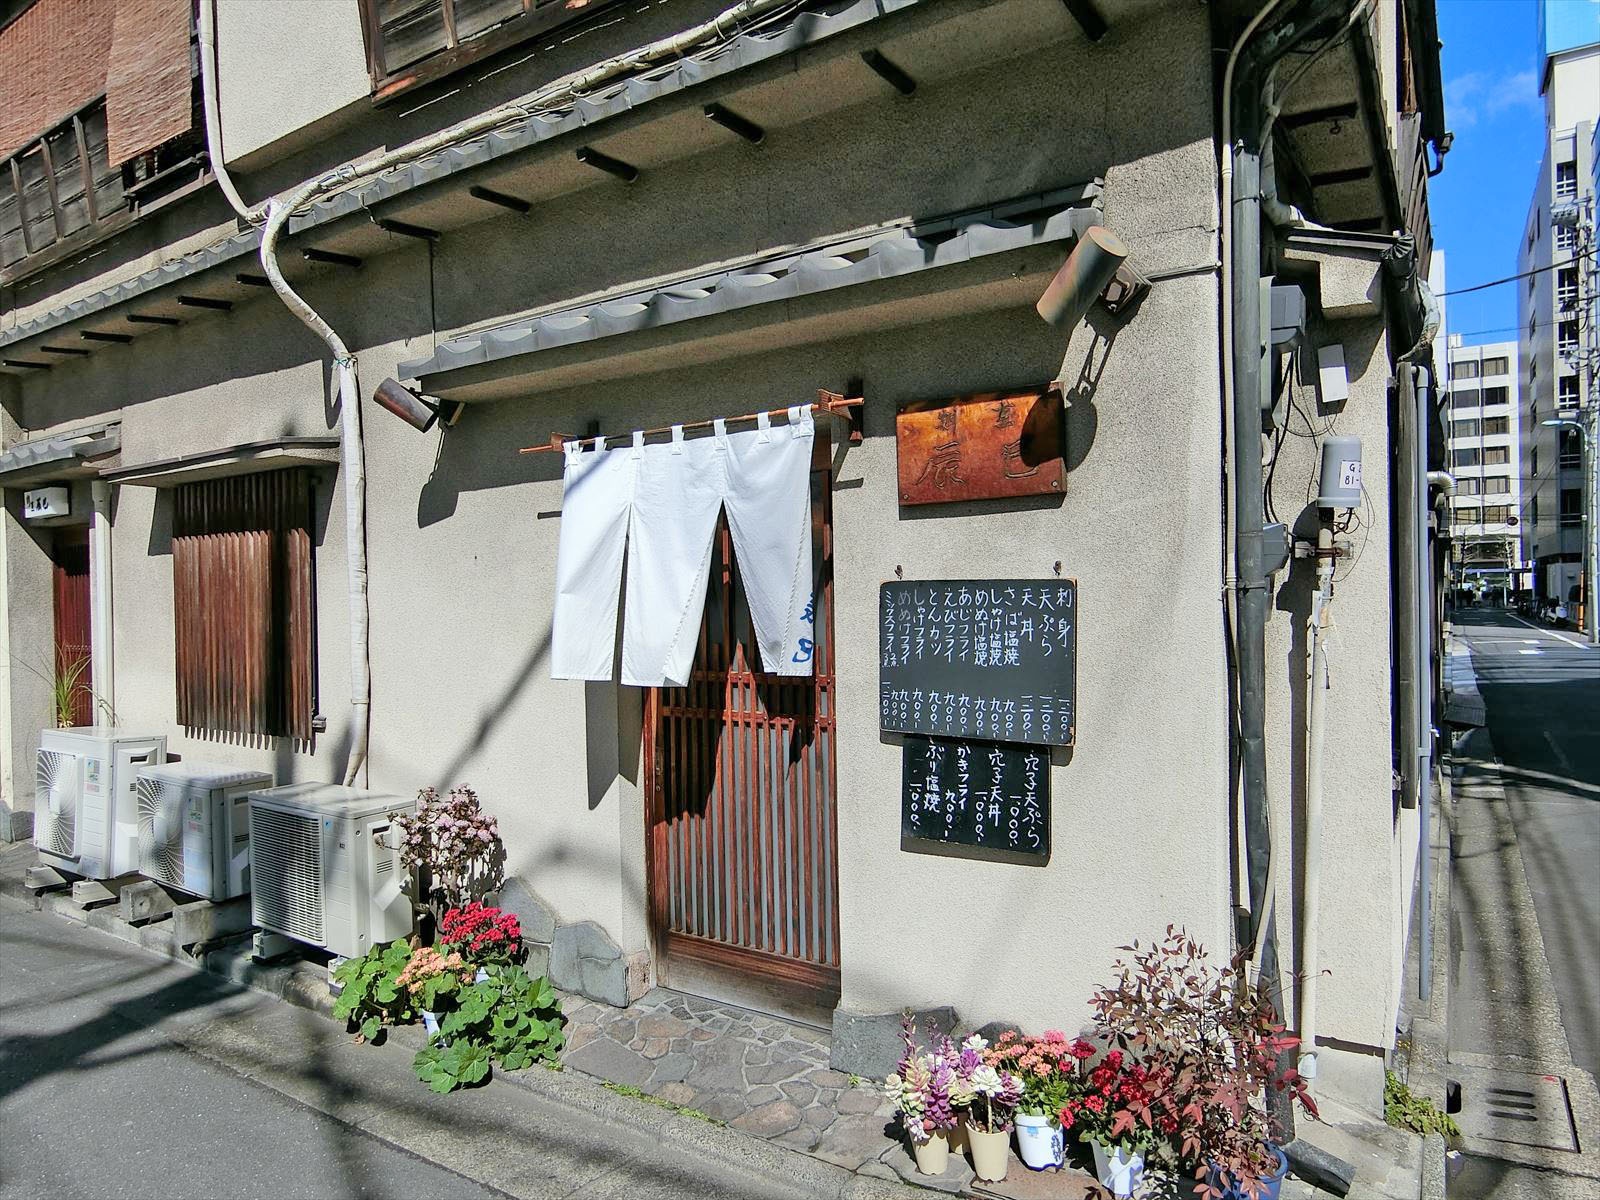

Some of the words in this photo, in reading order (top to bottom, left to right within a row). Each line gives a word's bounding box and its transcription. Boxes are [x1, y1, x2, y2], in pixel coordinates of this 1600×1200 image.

[1344, 475, 1362, 485] 81-
[1349, 463, 1356, 473] G
[928, 588, 942, 657] とんカツ
[958, 586, 973, 662] あじフライ
[1020, 588, 1037, 642] 天丼
[1038, 588, 1055, 657] 天ぷら
[1056, 587, 1072, 648] 刺身
[923, 737, 945, 813] ぶり塩焼
[957, 745, 971, 810] かきフライ
[988, 748, 1006, 828] 穴子天丼
[1022, 752, 1043, 848] 穴子天ぷら
